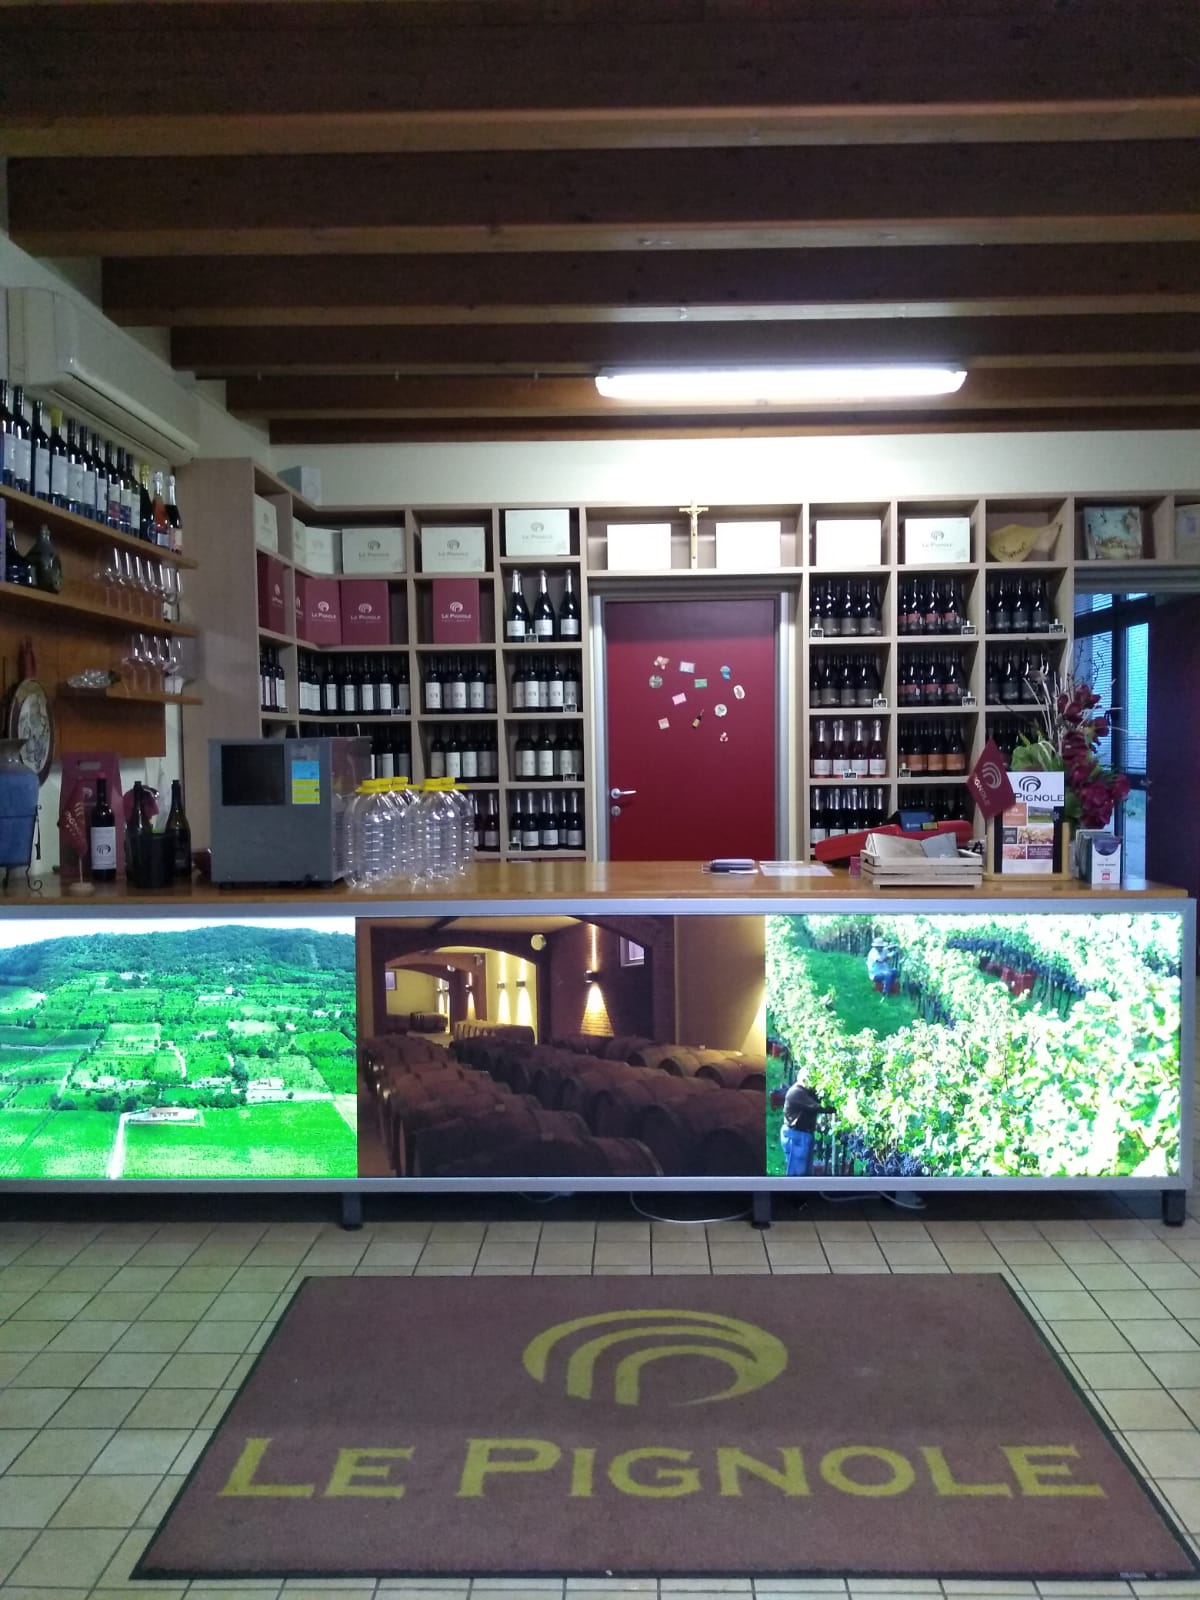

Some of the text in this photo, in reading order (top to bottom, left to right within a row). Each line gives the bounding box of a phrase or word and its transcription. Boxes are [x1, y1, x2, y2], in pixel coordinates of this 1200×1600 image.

[1013, 793, 1064, 802] PIGNOLE
[218, 1437, 1107, 1499] LE PIGNOLE
